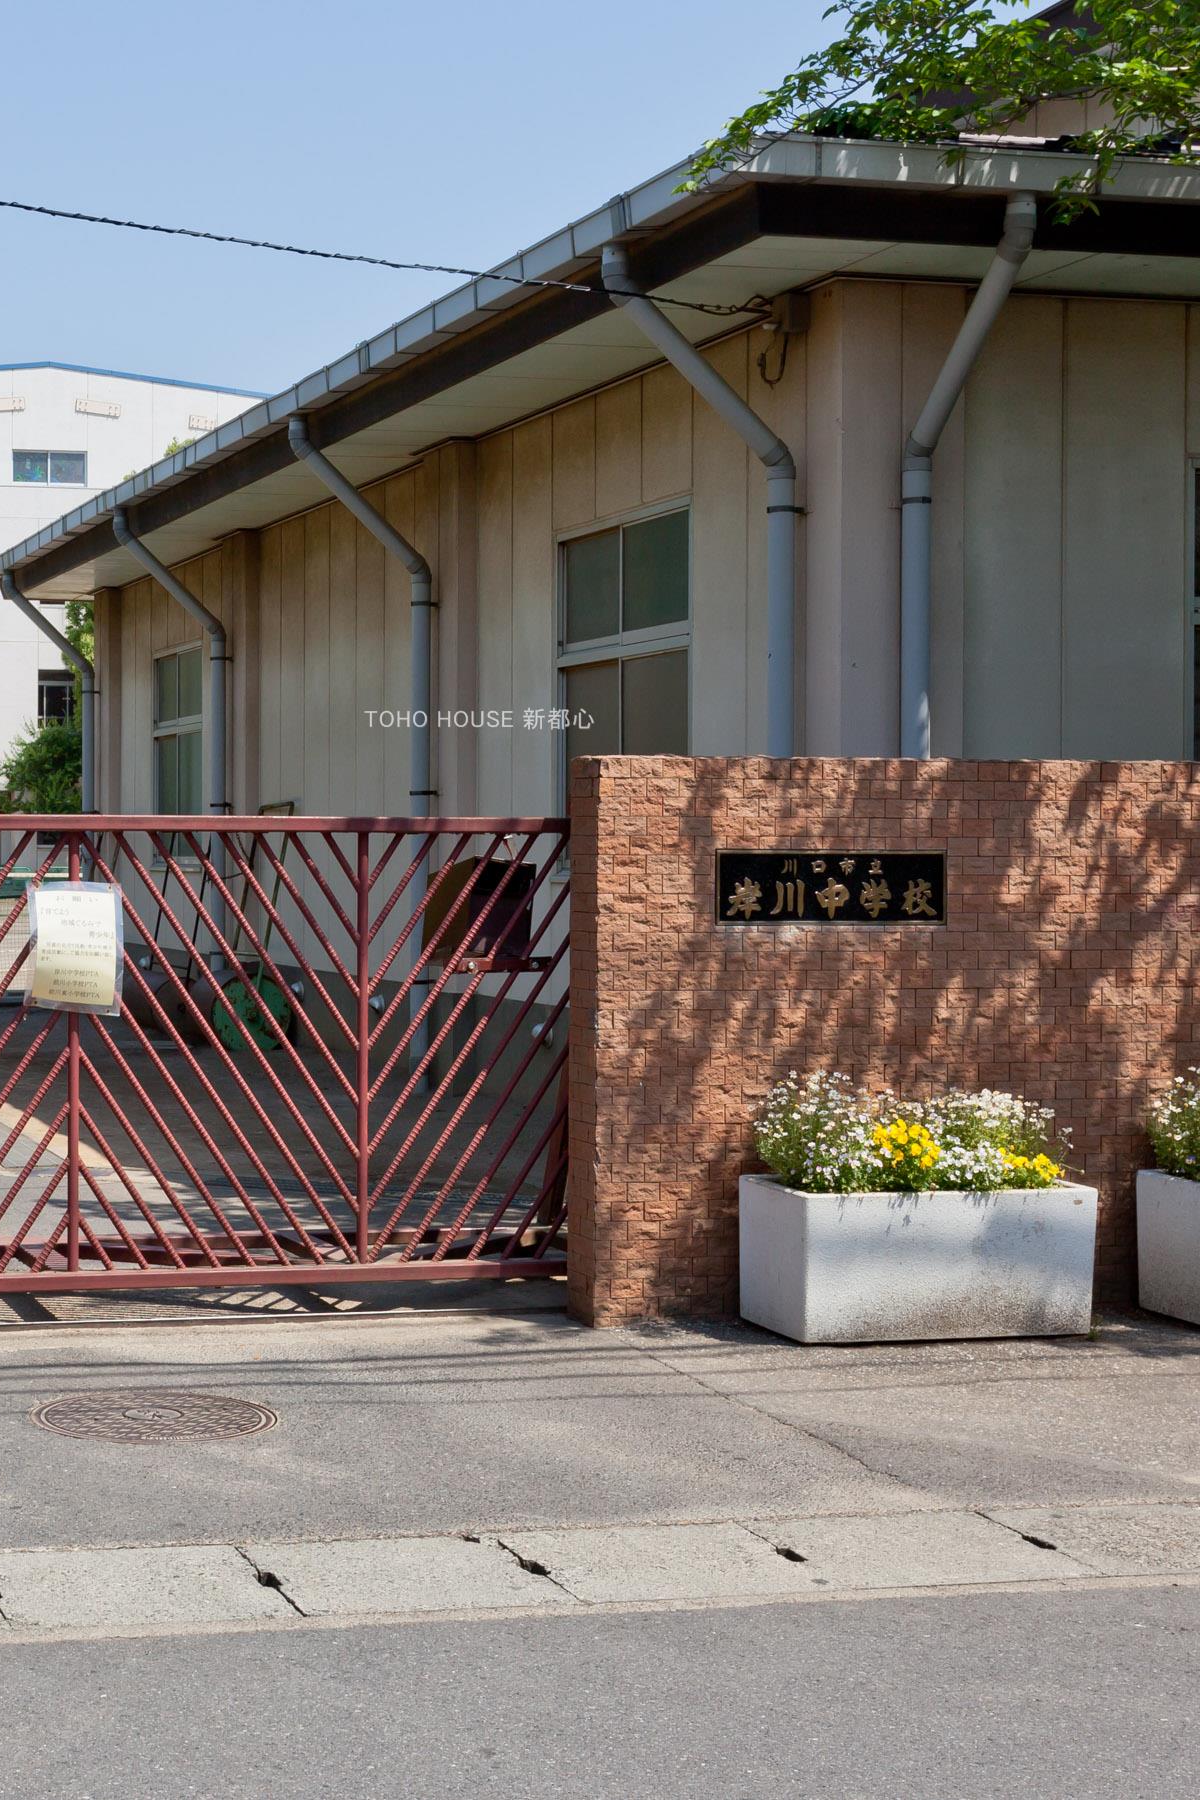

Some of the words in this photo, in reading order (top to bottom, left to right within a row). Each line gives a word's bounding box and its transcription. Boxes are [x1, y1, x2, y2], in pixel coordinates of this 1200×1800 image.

[781, 857, 883, 876] 川口市立
[726, 876, 938, 919] 岸川中学校
